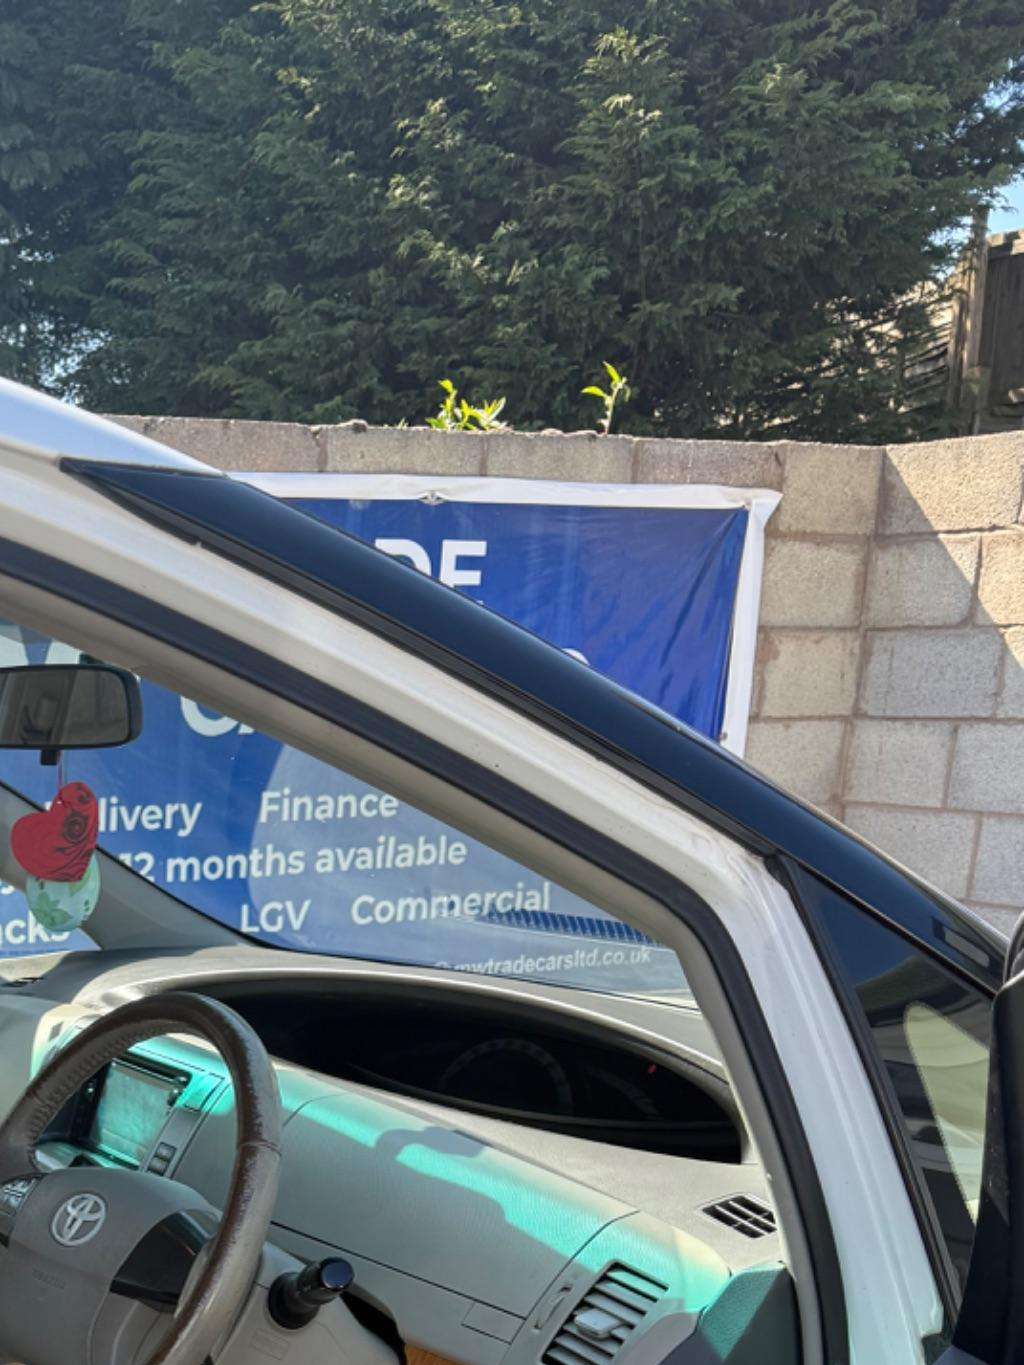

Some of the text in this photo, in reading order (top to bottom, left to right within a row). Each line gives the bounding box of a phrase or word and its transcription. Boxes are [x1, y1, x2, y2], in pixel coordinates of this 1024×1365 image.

[45, 797, 203, 837] livery
[259, 787, 400, 824] Finance
[166, 844, 306, 883] months
[315, 836, 468, 874] available
[241, 899, 312, 934] LGV
[351, 881, 551, 926] Commercial
